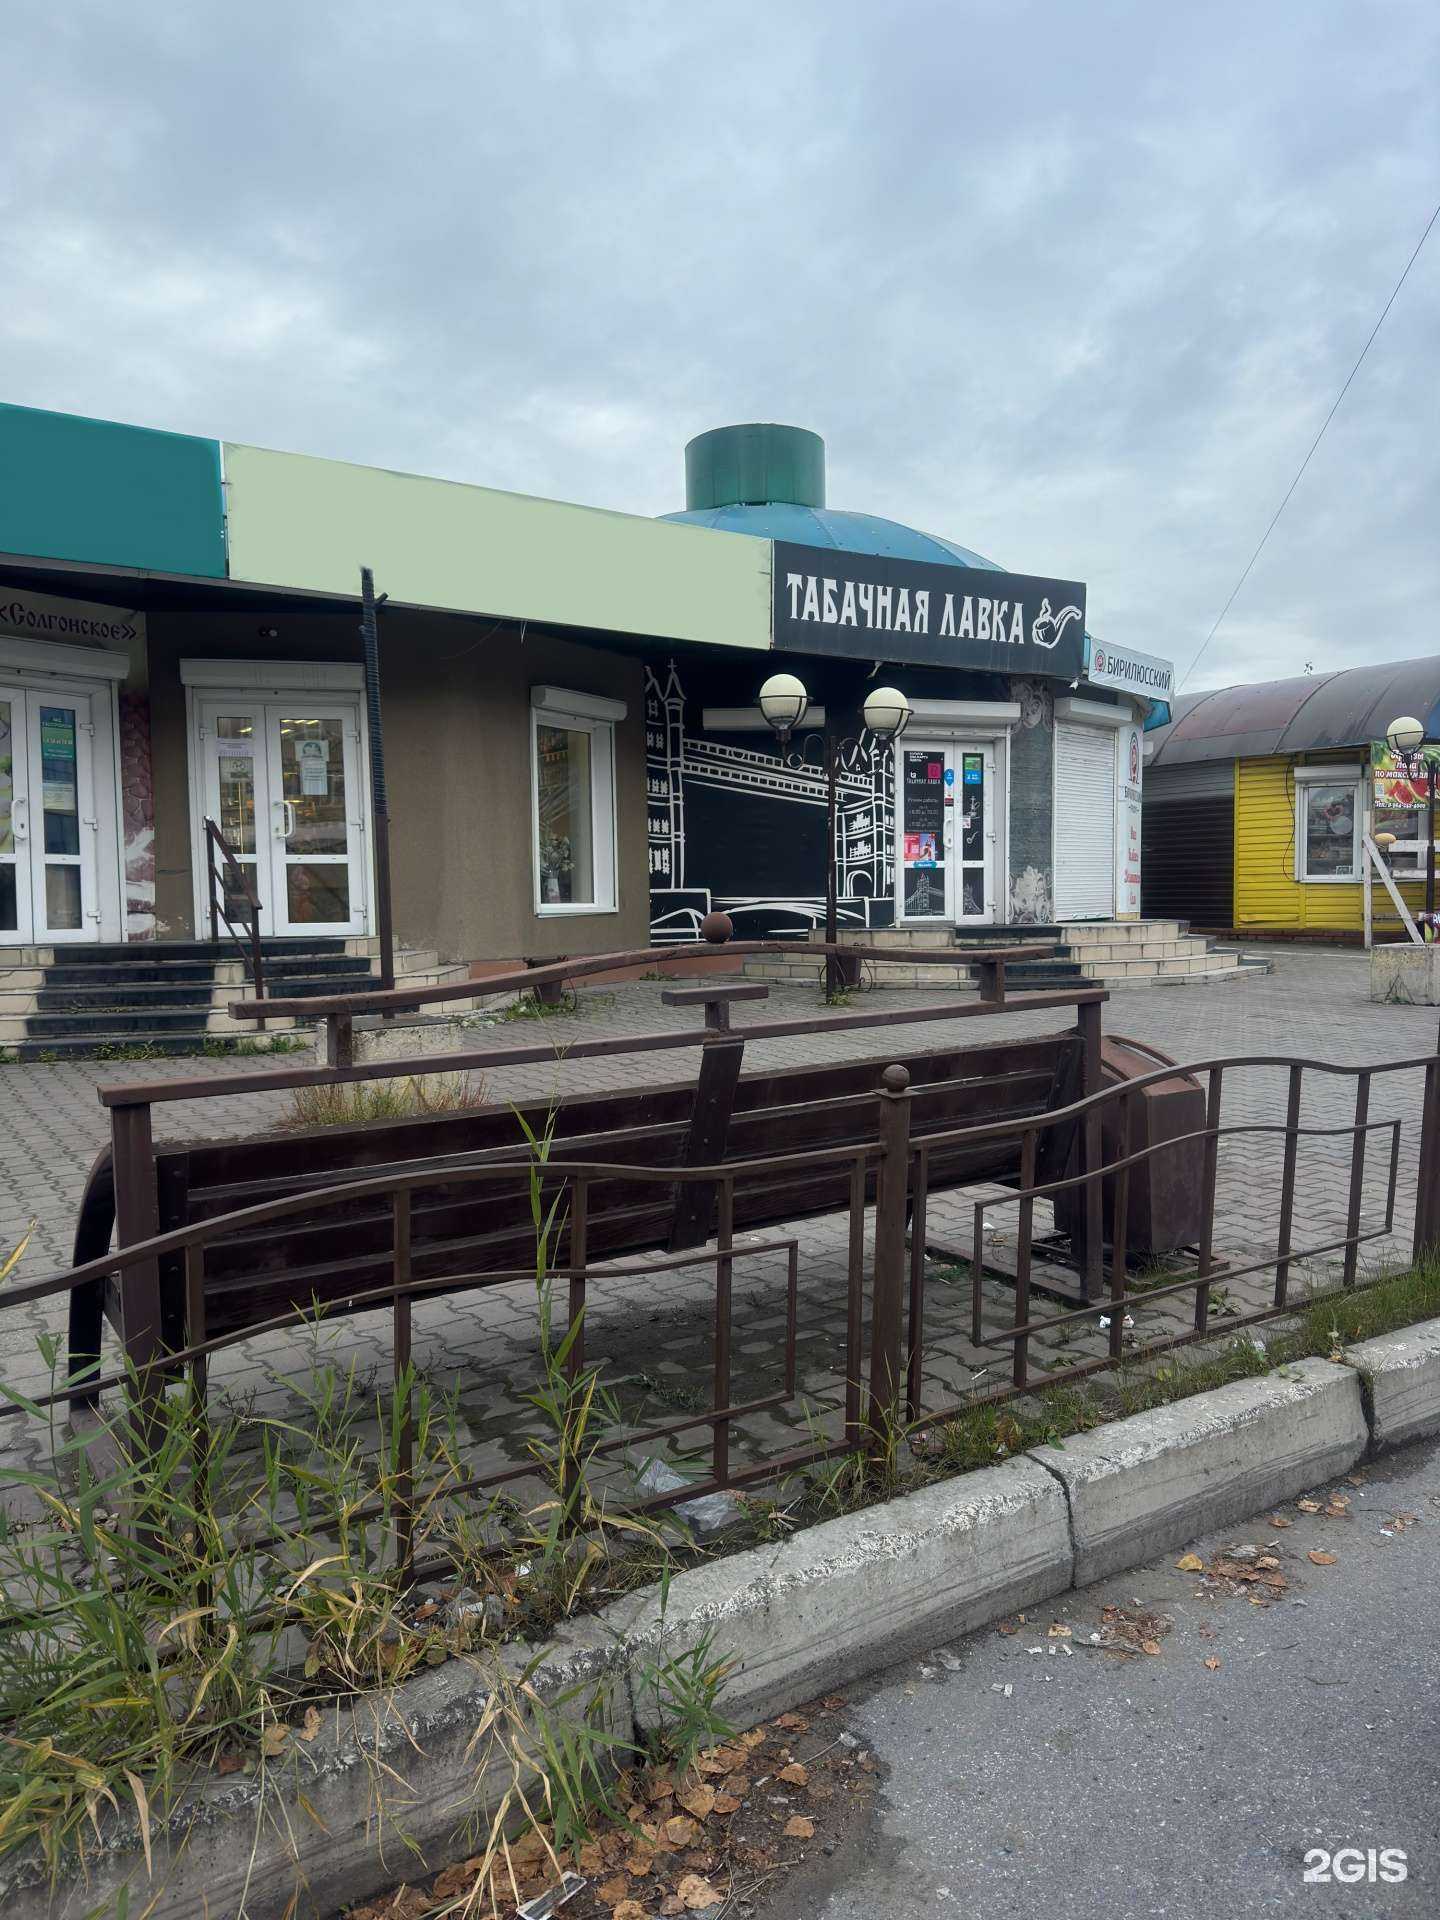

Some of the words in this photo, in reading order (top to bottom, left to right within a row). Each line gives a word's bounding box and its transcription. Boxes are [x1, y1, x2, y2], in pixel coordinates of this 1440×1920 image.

[786, 572, 930, 634] ТАБАЧНАЯ
[939, 593, 1024, 645] ЛАВКА
[1107, 654, 1171, 691] БИРИЛЮССКИЙ
